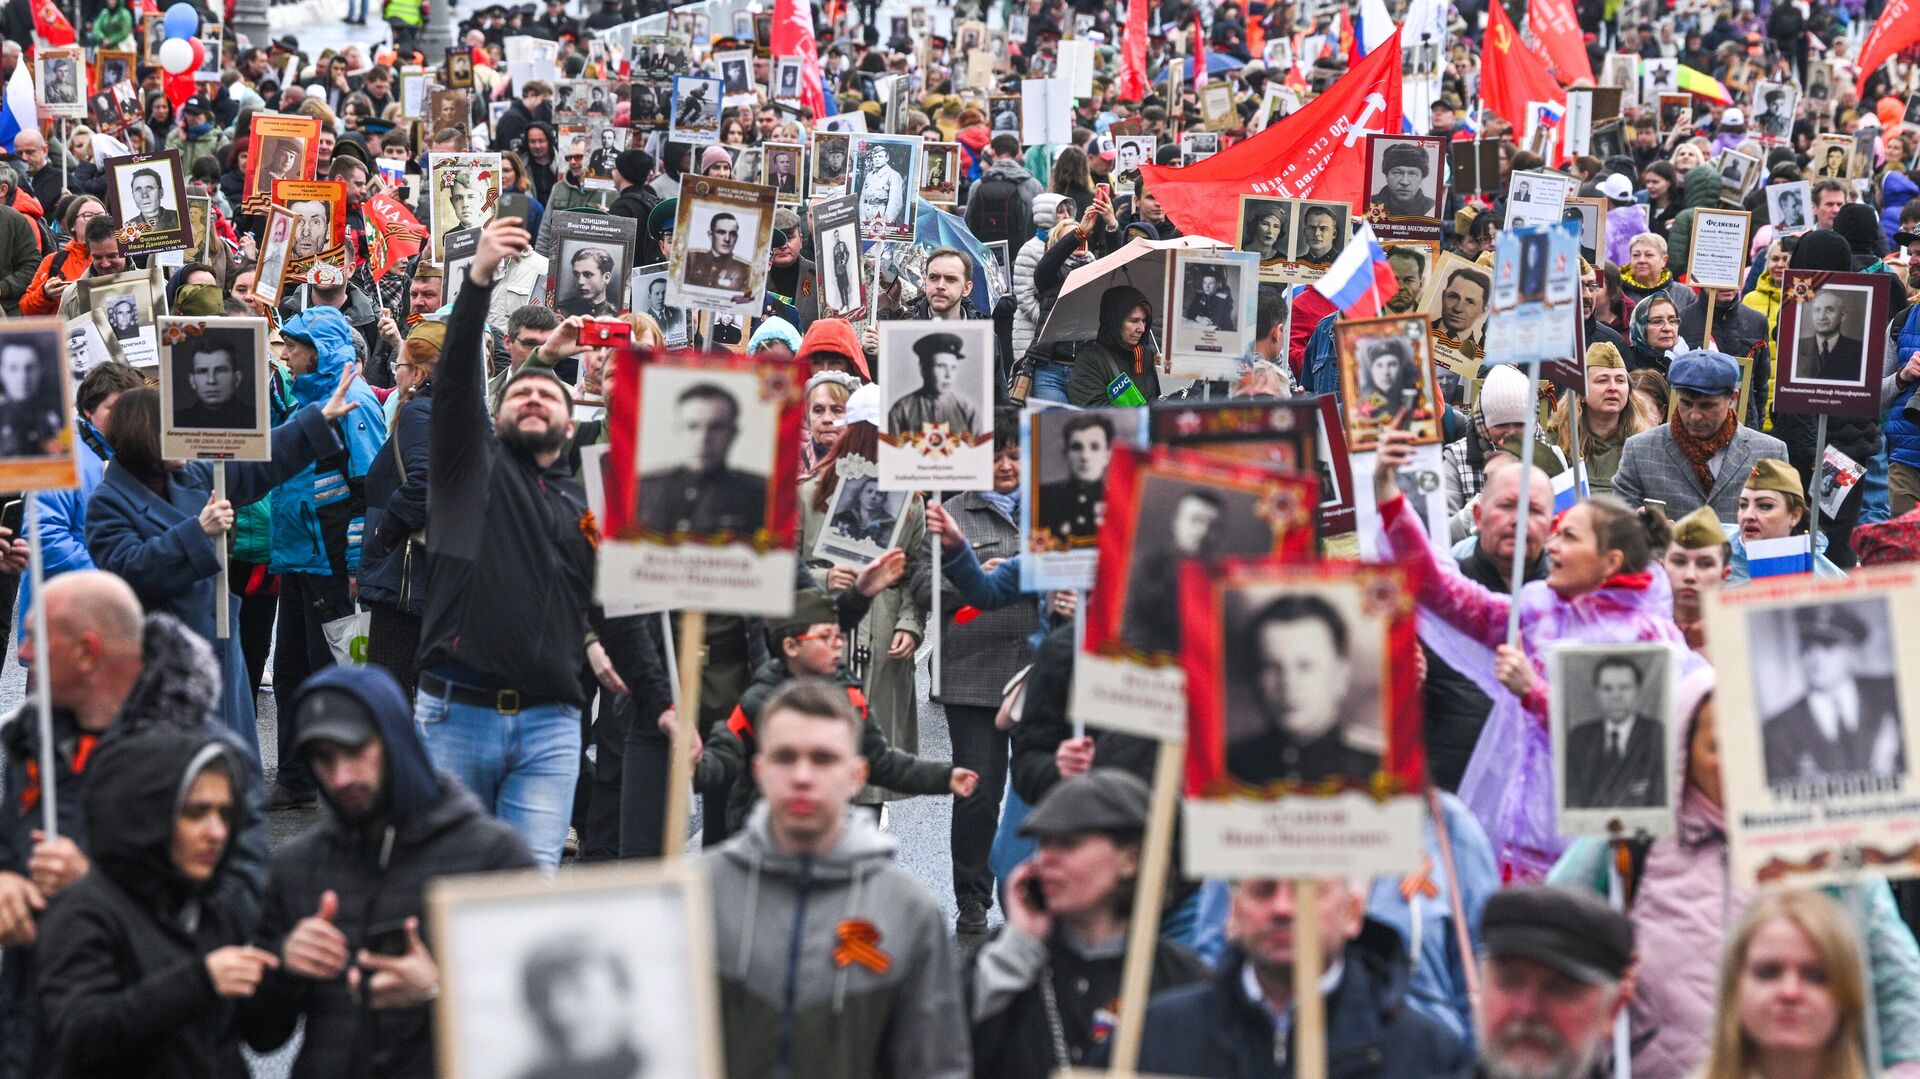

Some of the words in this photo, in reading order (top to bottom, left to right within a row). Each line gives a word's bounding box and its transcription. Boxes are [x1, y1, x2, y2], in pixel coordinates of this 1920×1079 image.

[580, 217, 609, 226] КЛИШИН
[567, 222, 589, 231] Виктор
[591, 224, 621, 233] Иванович
[145, 239, 182, 248] Данилович
